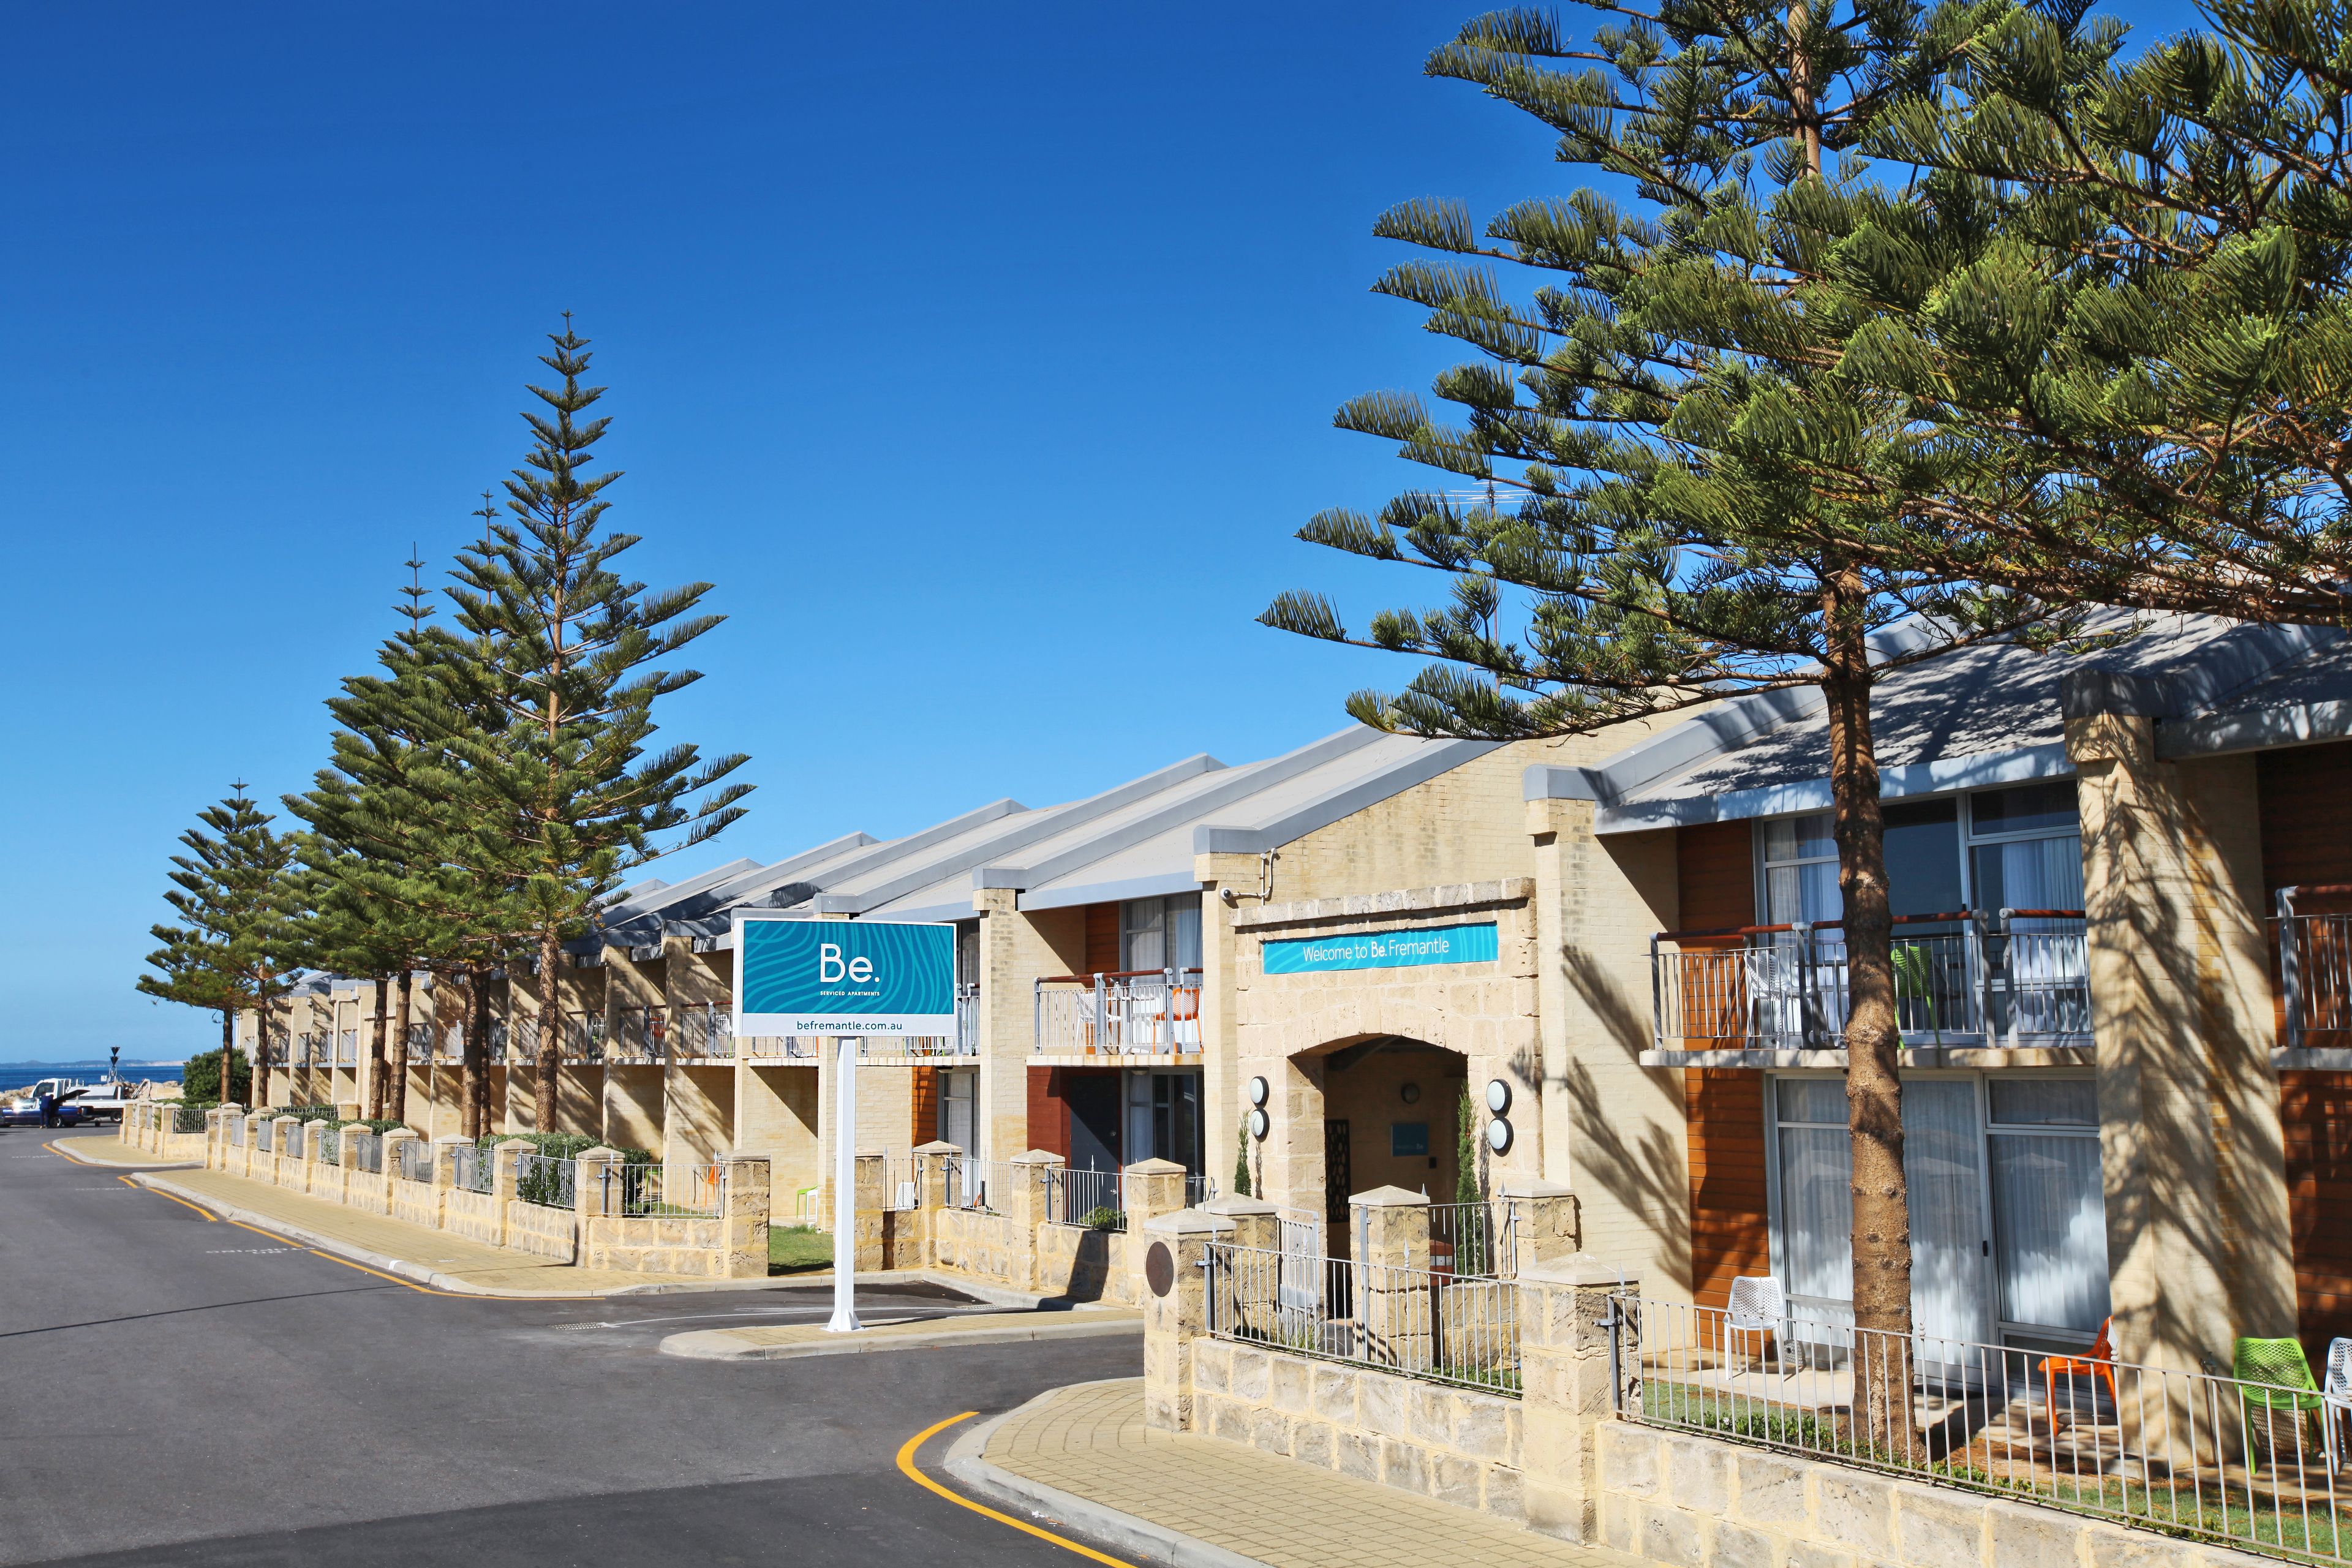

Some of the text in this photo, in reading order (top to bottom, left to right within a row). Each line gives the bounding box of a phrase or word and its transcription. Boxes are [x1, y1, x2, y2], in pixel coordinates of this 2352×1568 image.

[1303, 945, 1352, 962] Welcome
[1355, 944, 1368, 959] to
[1389, 937, 1449, 956] Fremantle
[820, 943, 880, 983] Be.
[797, 1020, 903, 1030] befremantle.com.au
